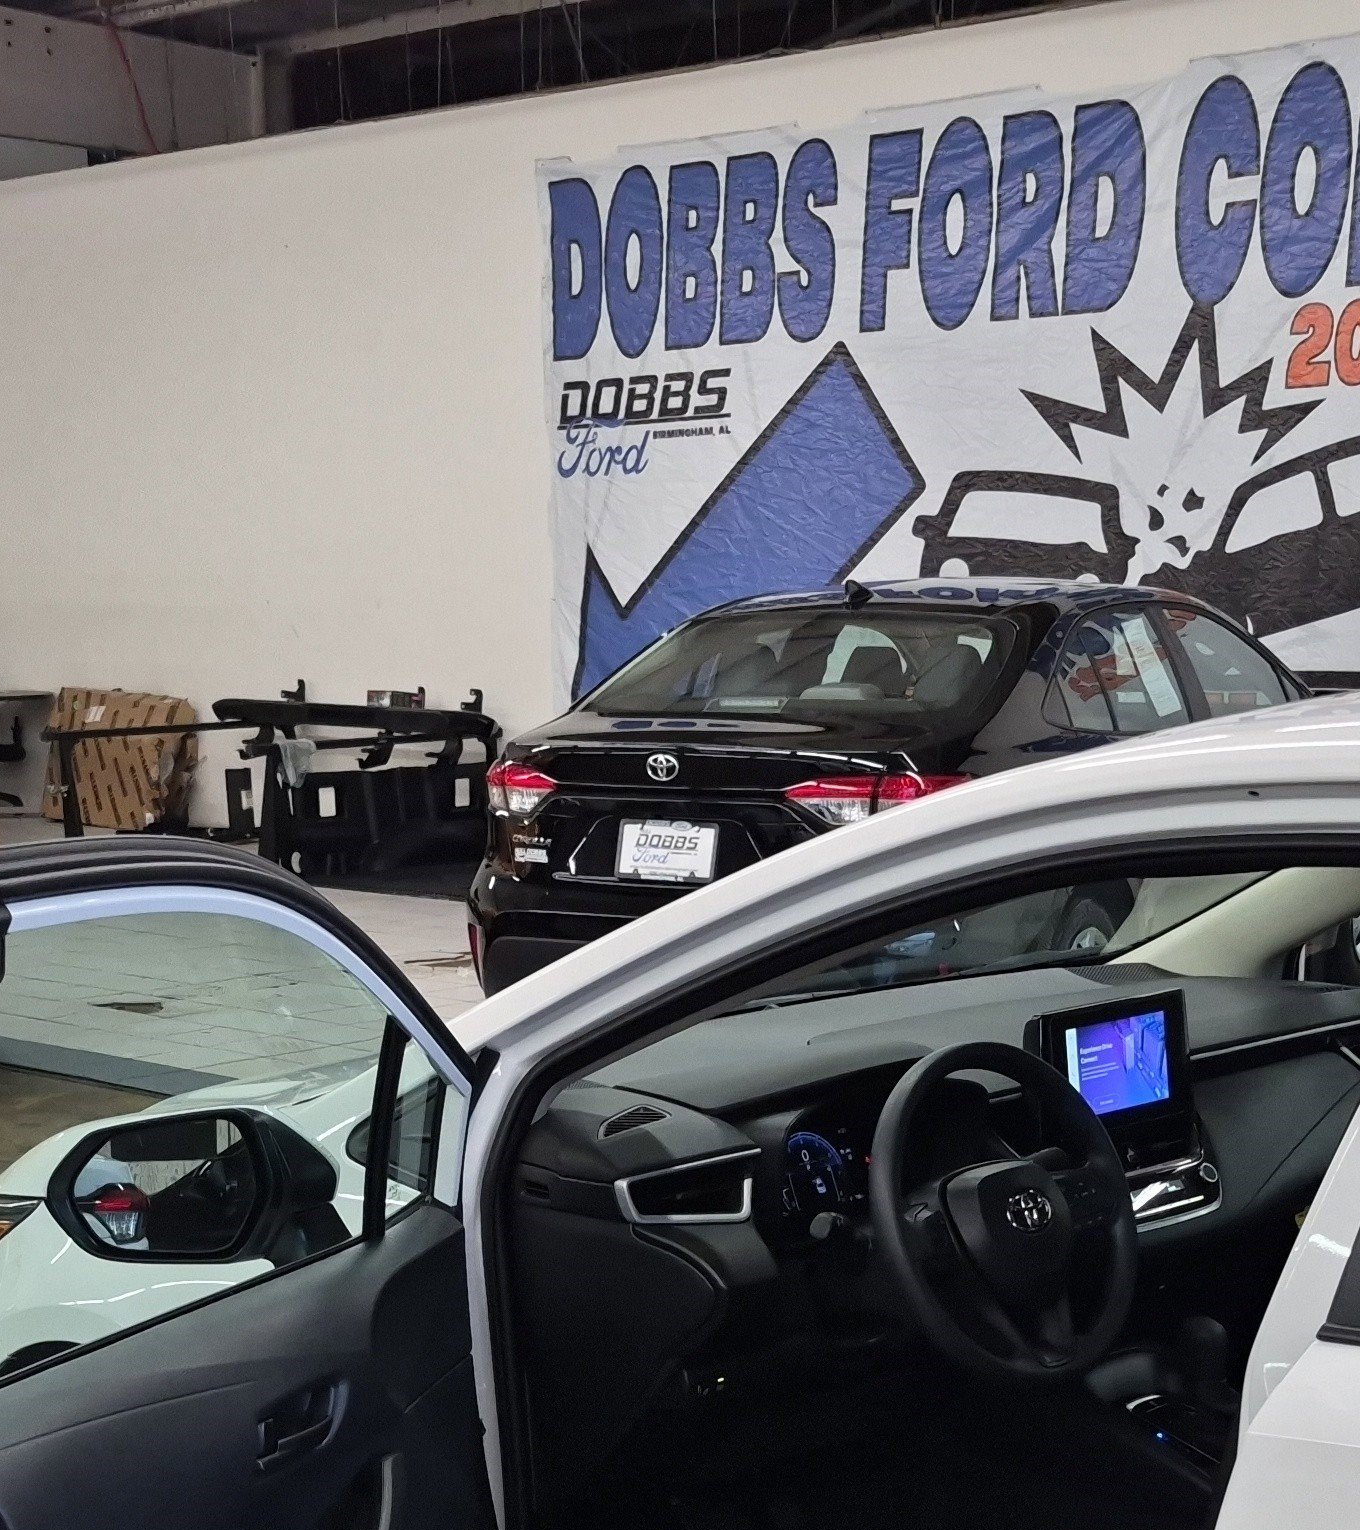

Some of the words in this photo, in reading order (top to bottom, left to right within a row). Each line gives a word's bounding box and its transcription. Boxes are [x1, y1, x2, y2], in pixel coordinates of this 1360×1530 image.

[548, 139, 838, 362] DOBBS
[860, 99, 1146, 333] FORD
[559, 368, 732, 425] DOBBS
[557, 416, 651, 478] Ford
[632, 846, 669, 864] Ford
[635, 833, 700, 850] DOBBS
